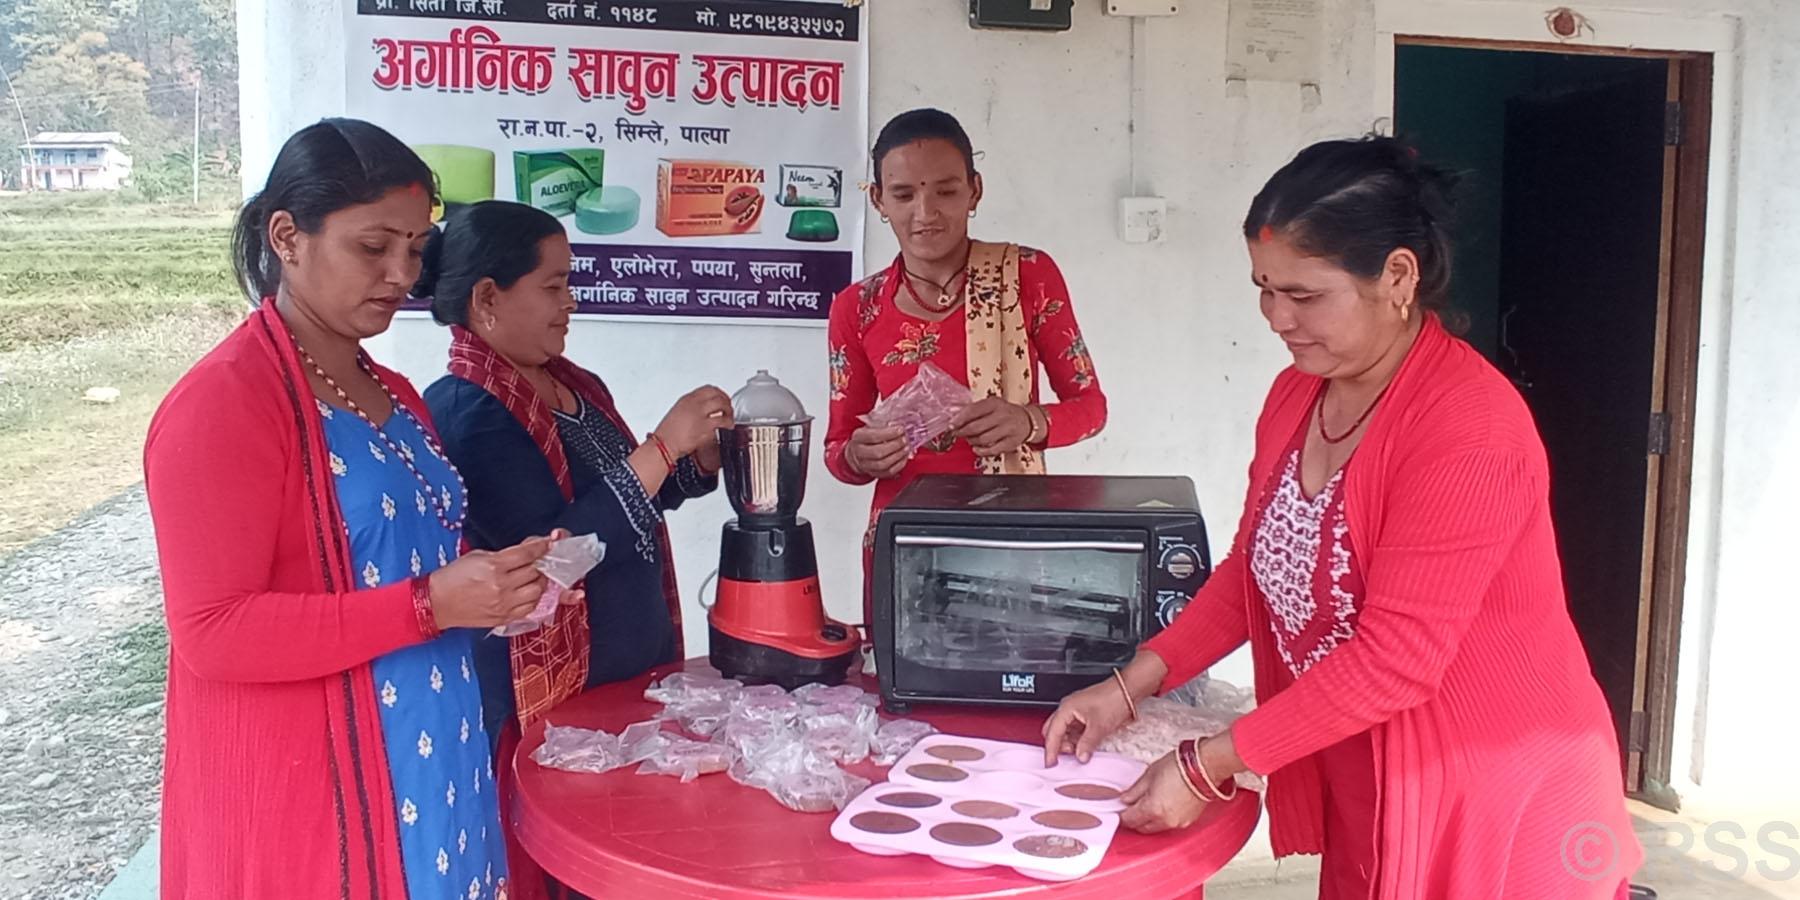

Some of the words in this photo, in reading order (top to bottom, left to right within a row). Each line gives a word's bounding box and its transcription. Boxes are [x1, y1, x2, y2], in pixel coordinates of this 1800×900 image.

[610, 6, 657, 24] ११४८
[695, 8, 720, 28] मो.
[729, 13, 845, 37] ९८१९४३५५७२
[372, 25, 556, 96] अर्गानिक
[692, 54, 845, 114] उत्पादन
[615, 117, 668, 146] सिम्ले,
[680, 125, 731, 145] पाल्पा
[701, 167, 765, 184] PAPAYA
[610, 253, 682, 280] एलोभेरा,
[749, 261, 807, 284] सुन्तला,
[696, 289, 760, 309] उत्पादन
[766, 285, 821, 311] गरिन्छ
